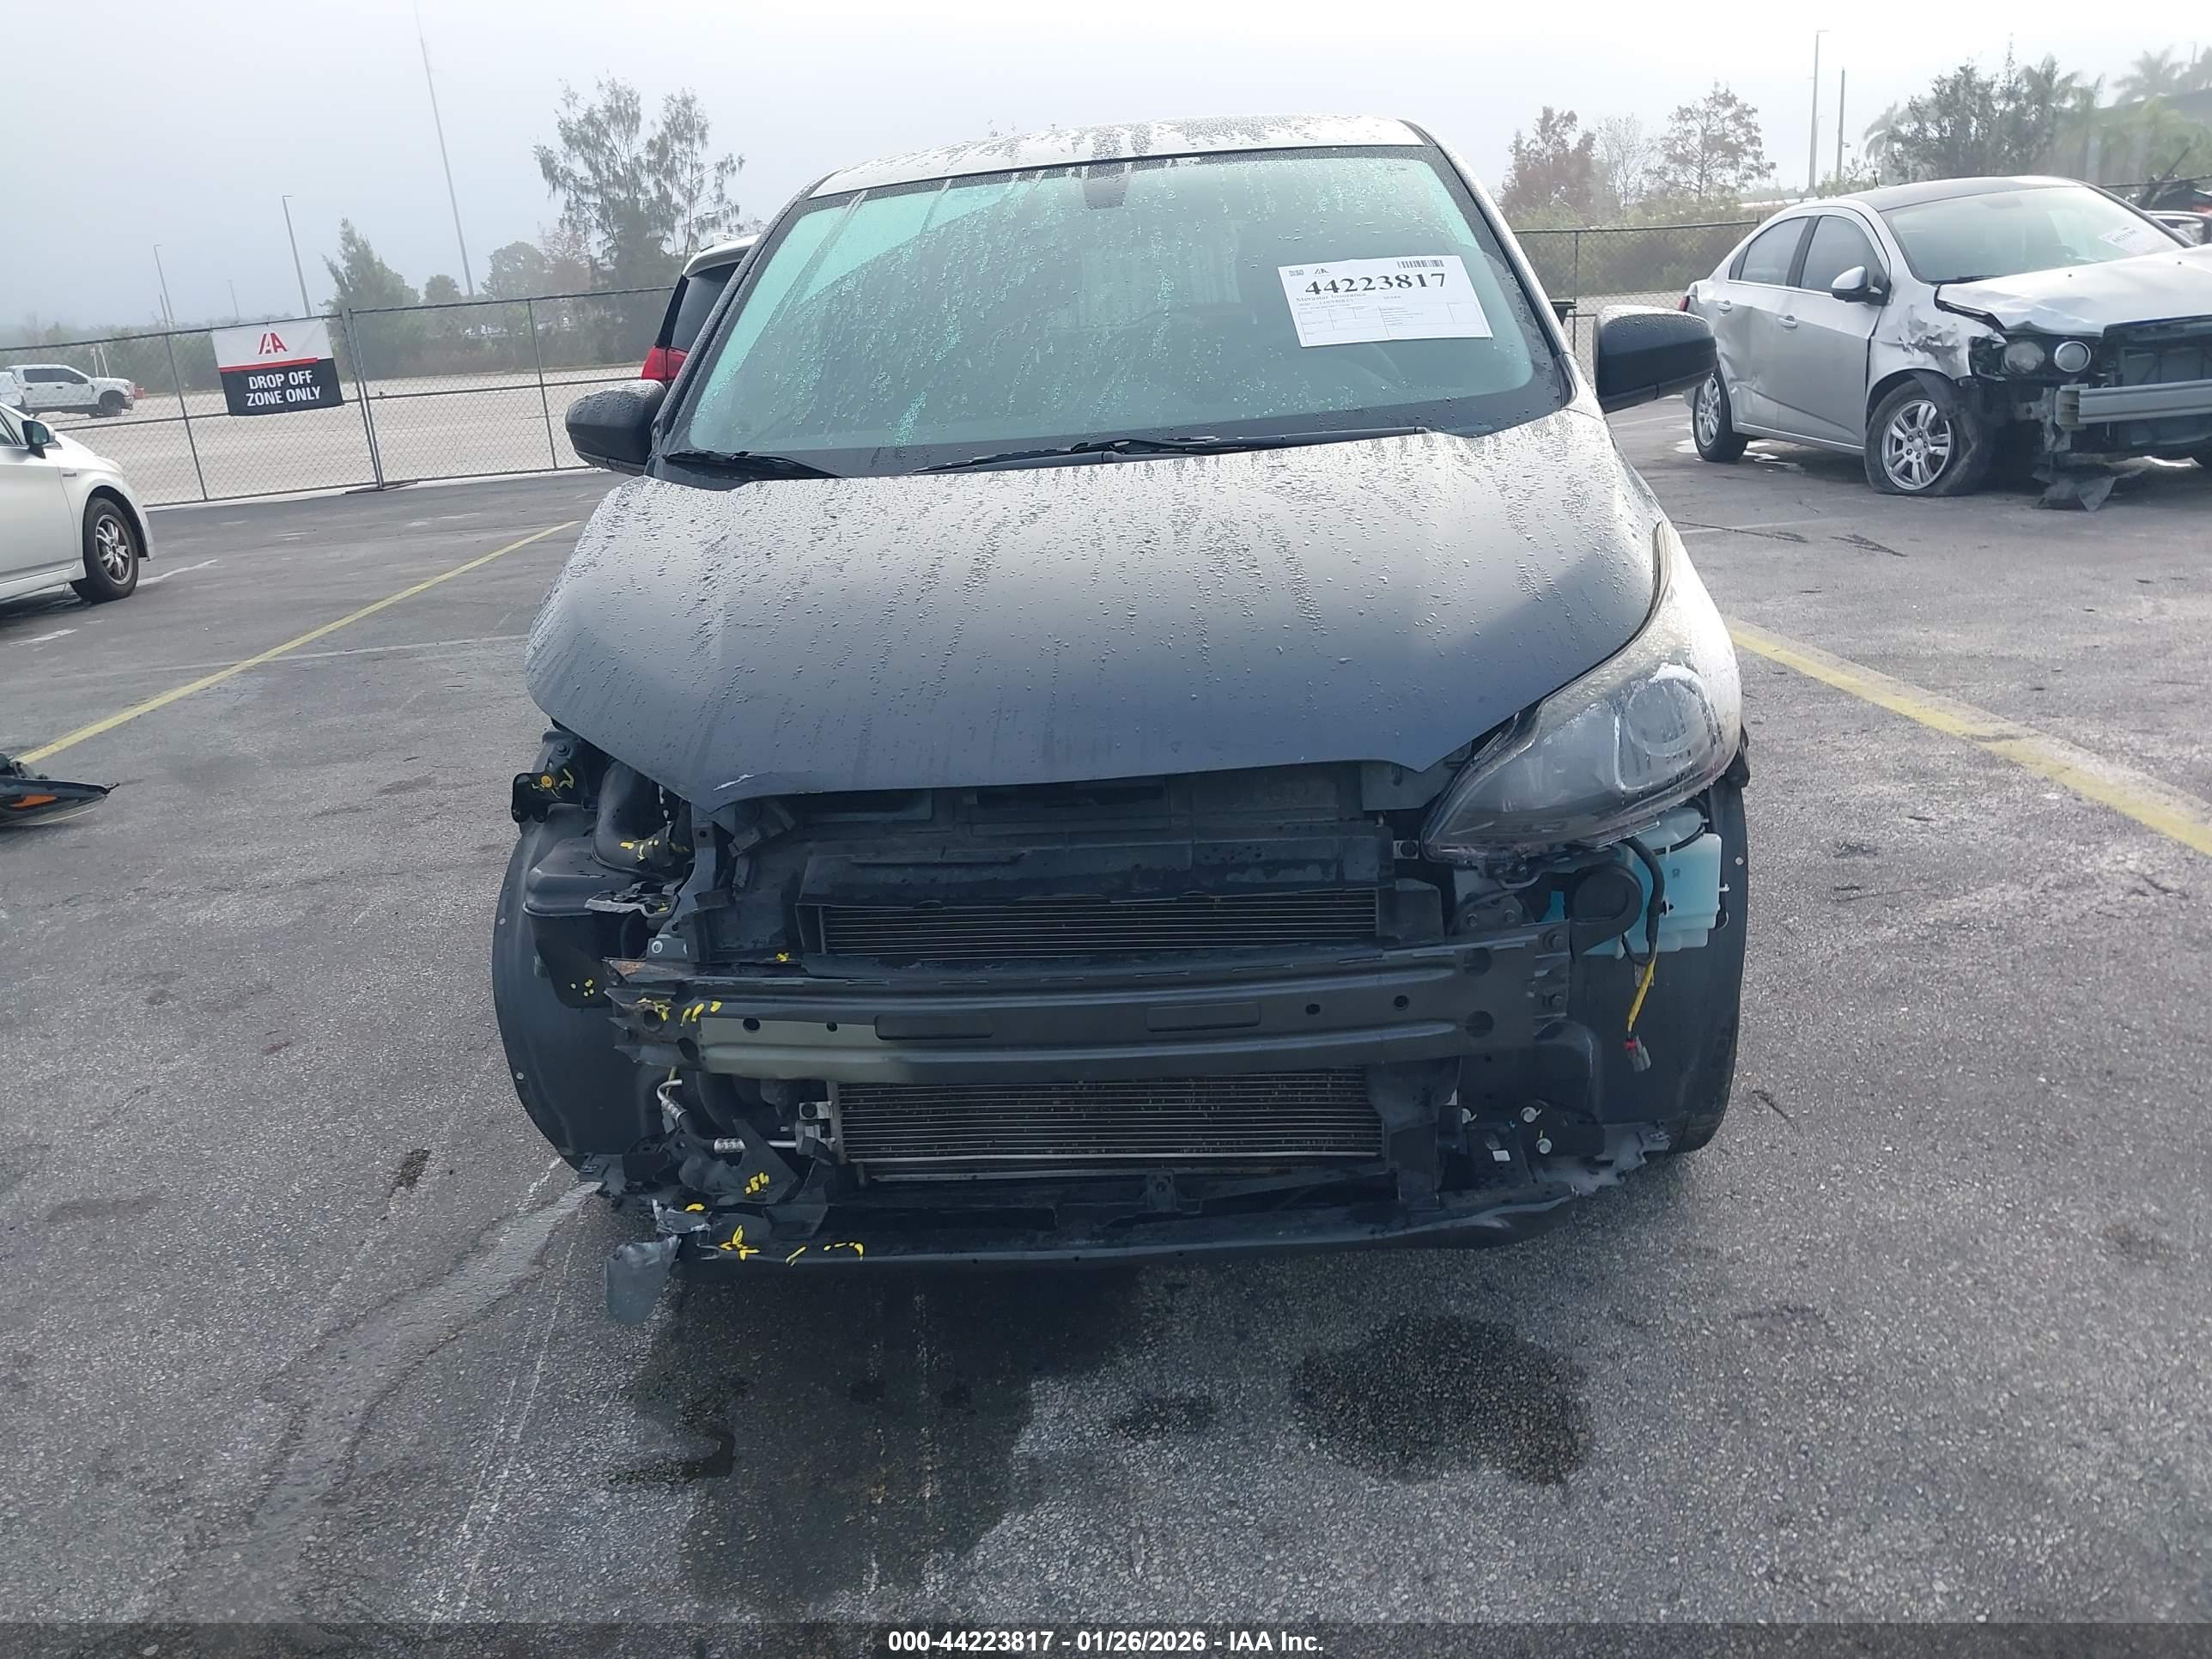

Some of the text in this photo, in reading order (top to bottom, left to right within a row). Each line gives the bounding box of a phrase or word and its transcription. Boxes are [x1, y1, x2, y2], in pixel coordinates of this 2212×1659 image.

[1305, 272, 1446, 295] 44223817
[258, 332, 289, 355] IAA
[248, 370, 313, 390] DROP OFF
[246, 386, 320, 407] ZONE ONLY
